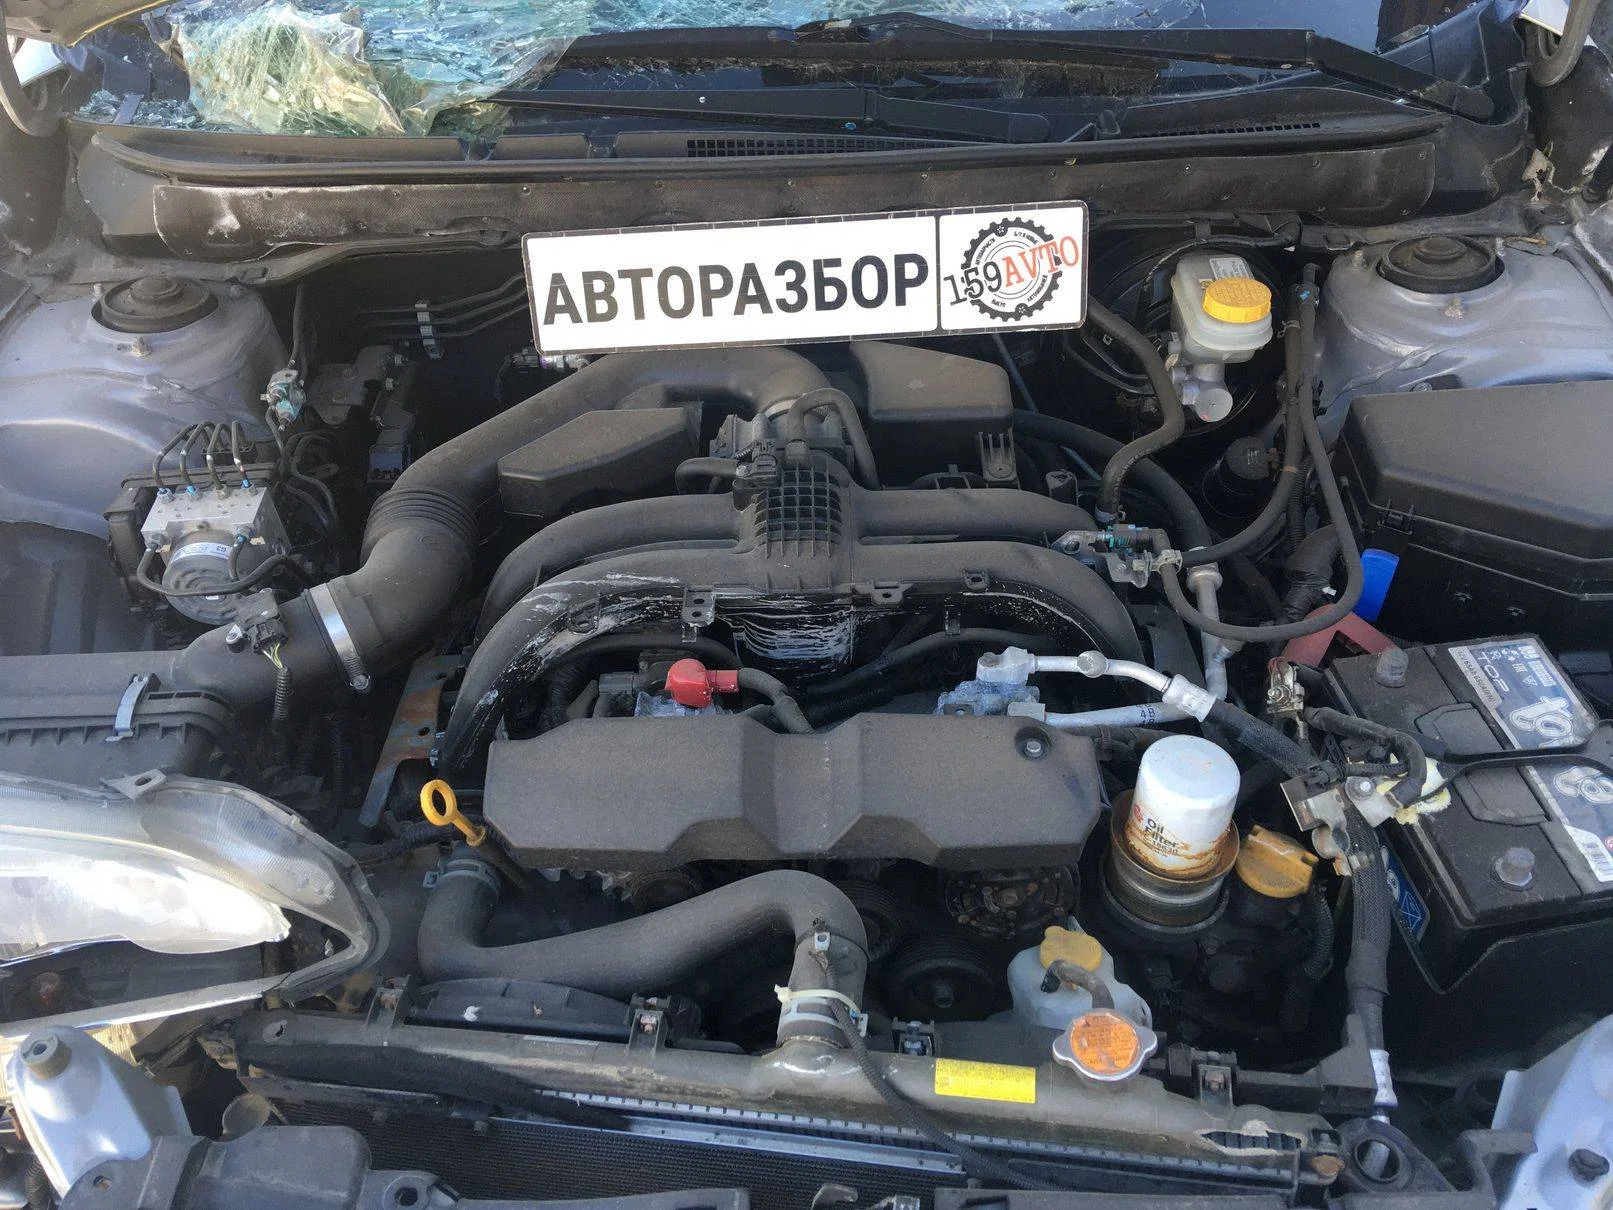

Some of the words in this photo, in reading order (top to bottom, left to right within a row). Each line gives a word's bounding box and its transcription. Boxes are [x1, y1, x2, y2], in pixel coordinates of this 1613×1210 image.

[543, 253, 929, 325] АВТОРАЗБОР
[1478, 651, 1510, 692] TOP
[1140, 707, 1156, 718] 4B
[1145, 825, 1180, 848] Filter
[1147, 818, 1165, 835] Oil
